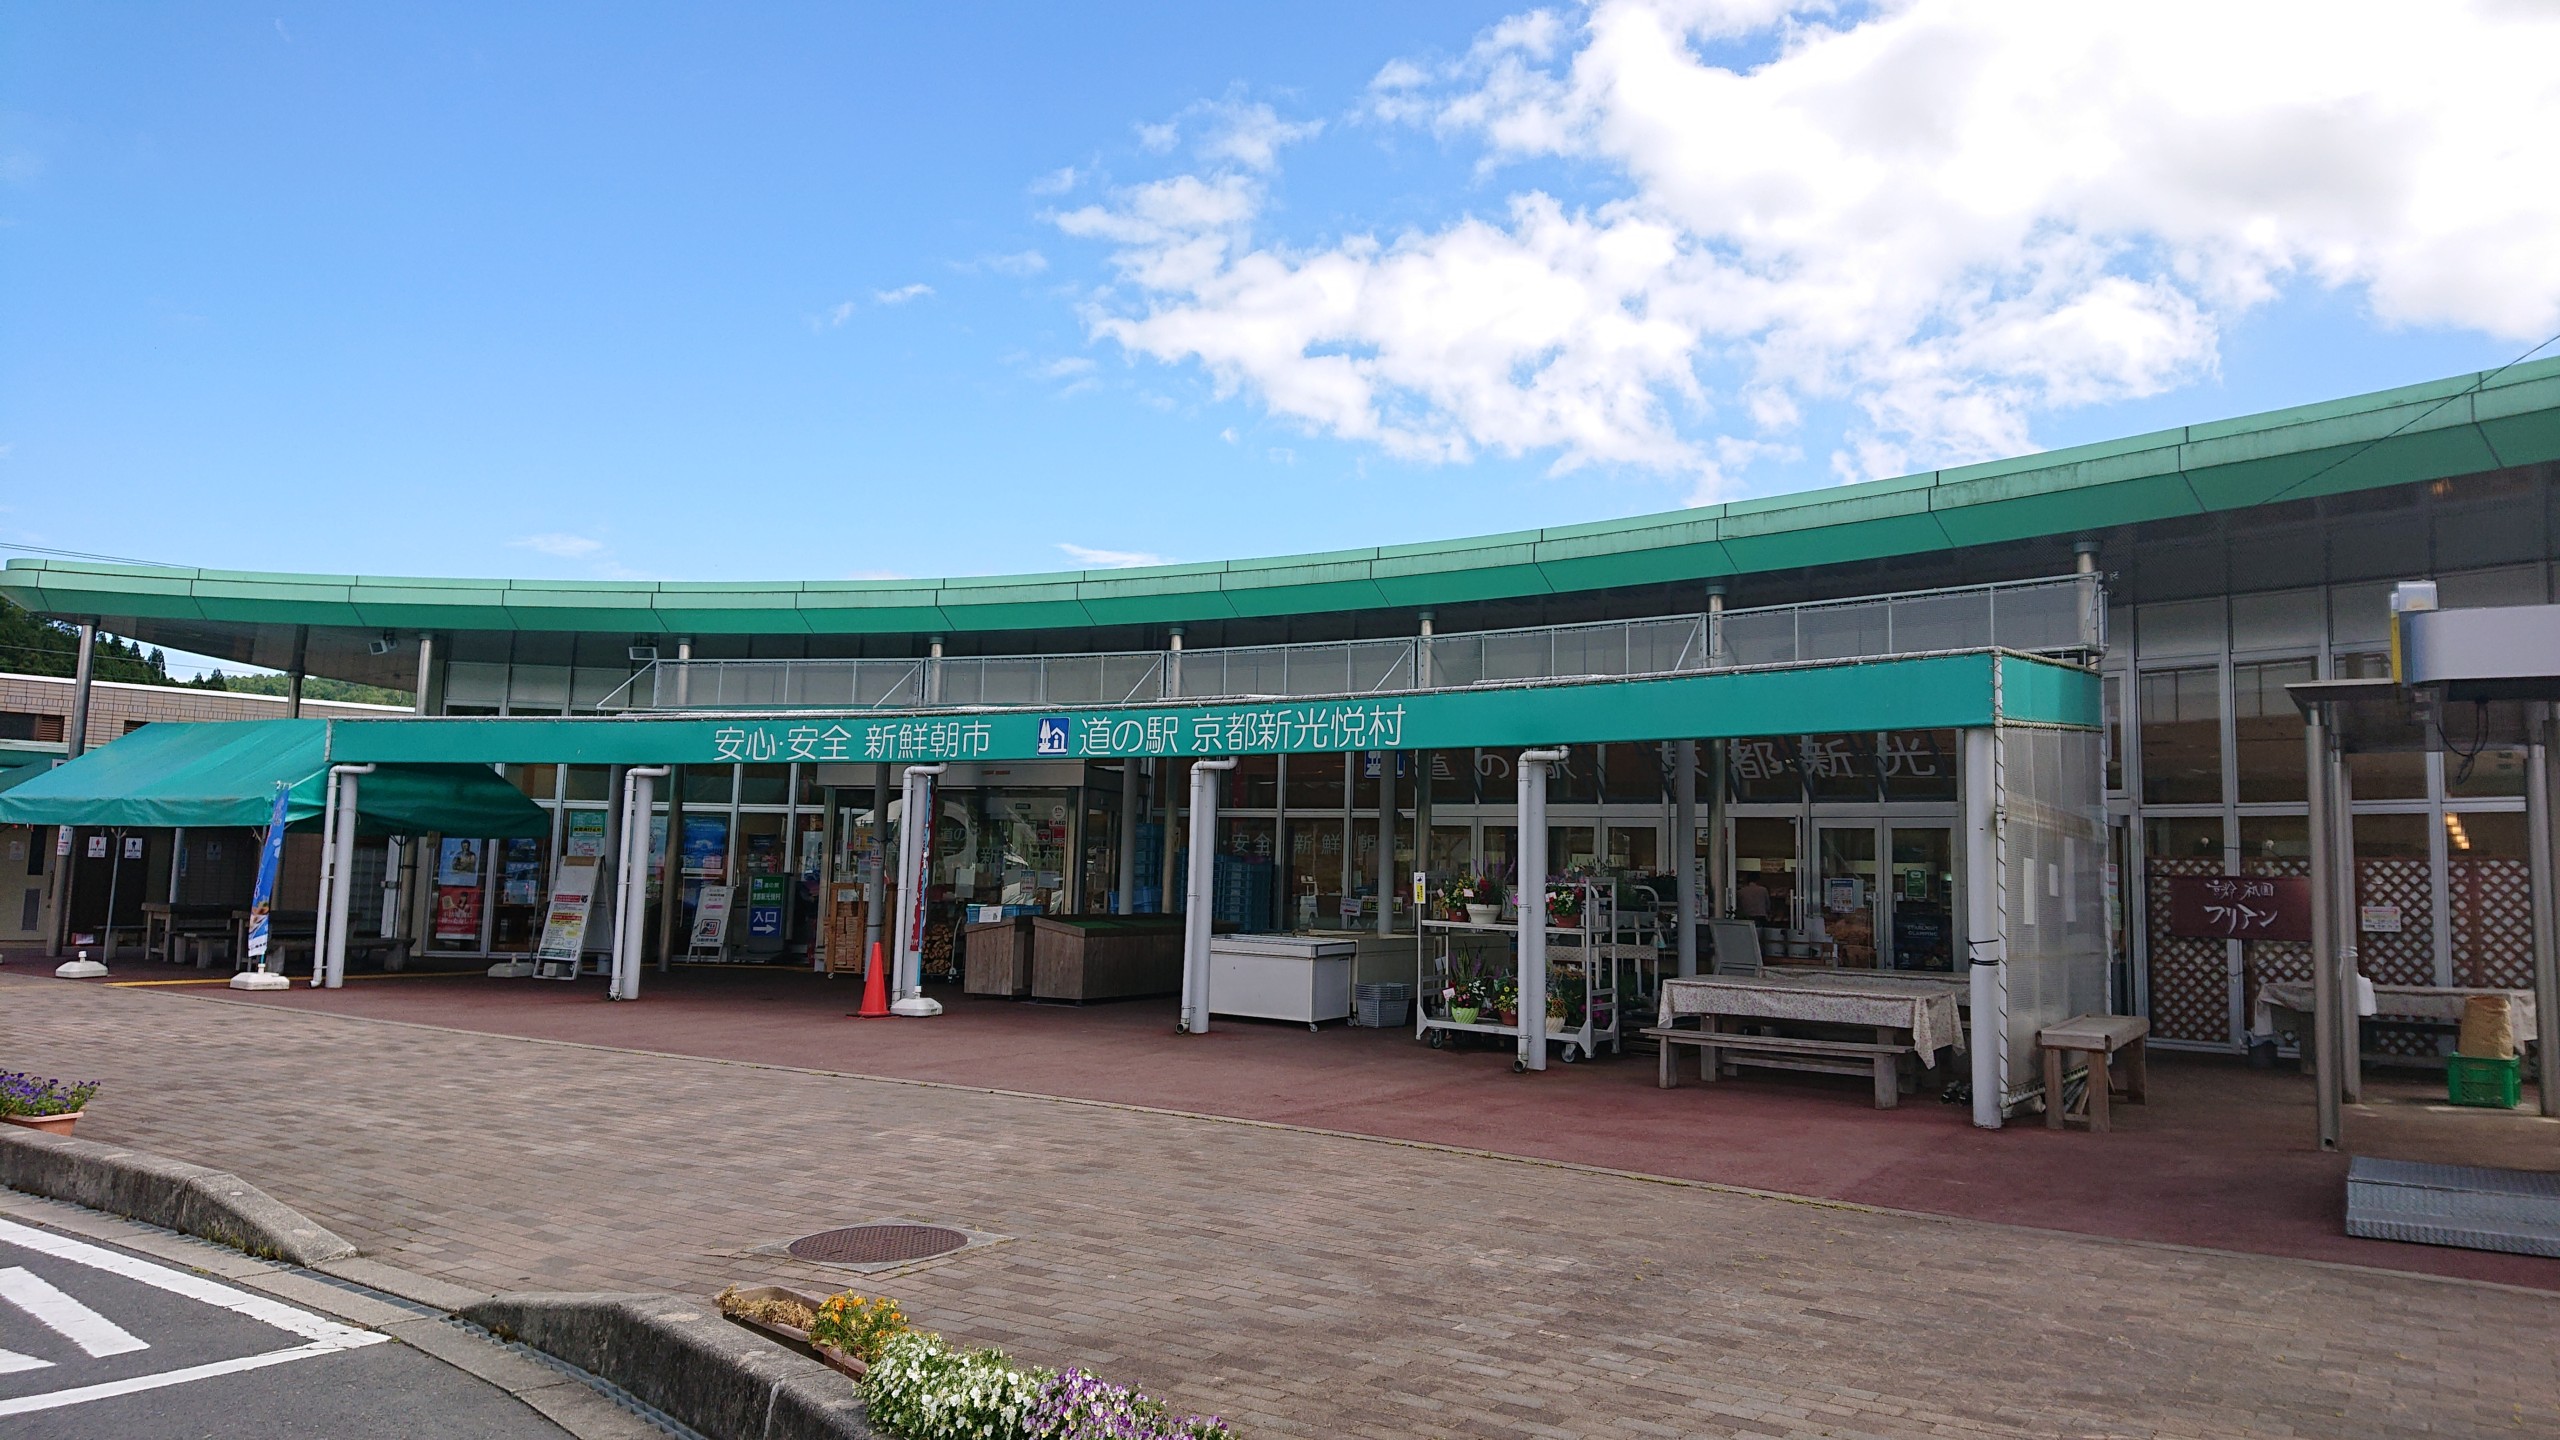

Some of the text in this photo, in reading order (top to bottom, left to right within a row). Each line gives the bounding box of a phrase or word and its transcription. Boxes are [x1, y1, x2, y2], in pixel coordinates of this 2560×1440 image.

[864, 720, 992, 759] 新鮮朝市
[1078, 716, 1178, 755] 道の駅
[1191, 703, 1406, 753] 京都新光悦村
[753, 911, 777, 923] 入口
